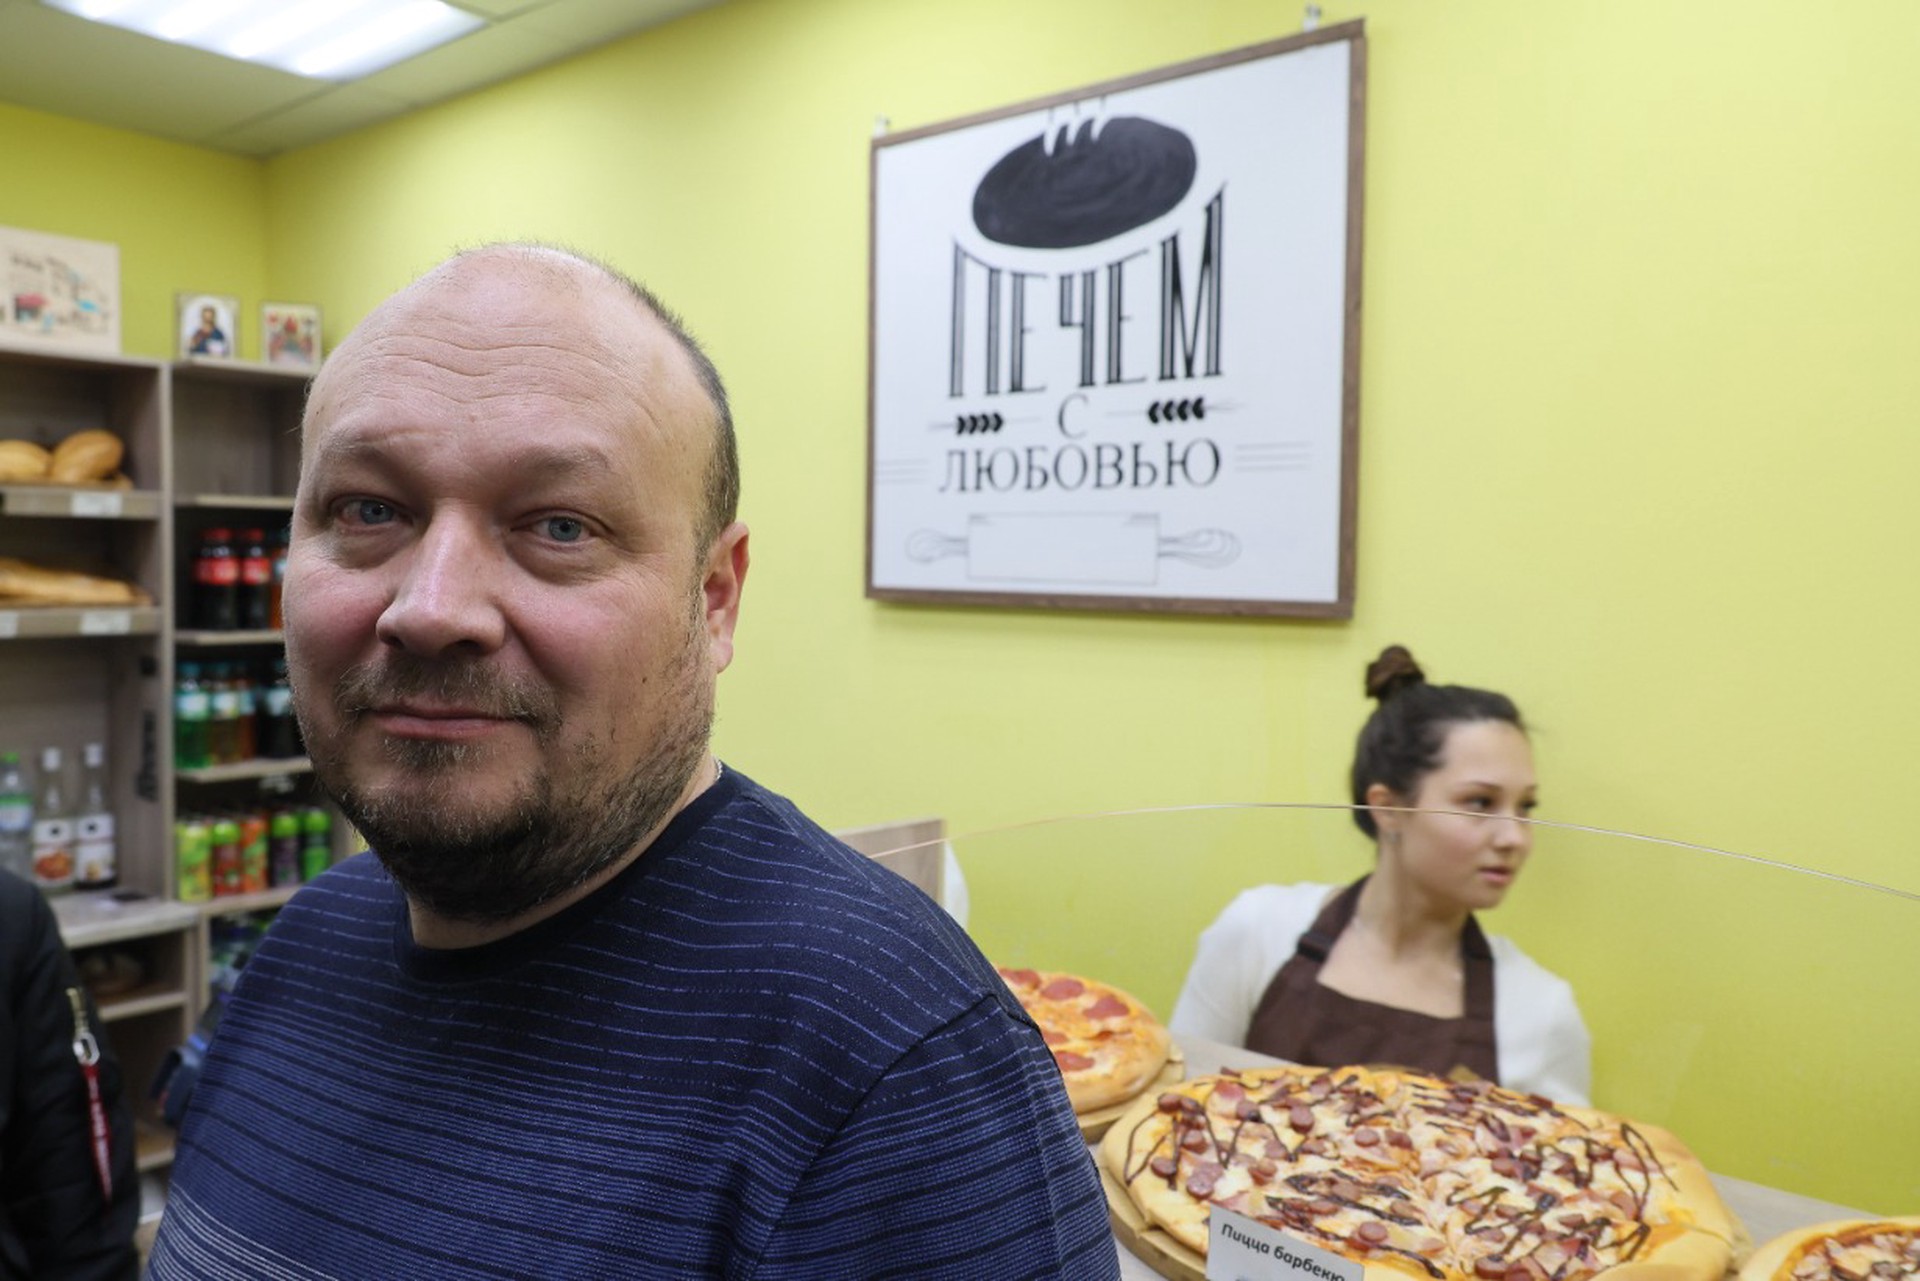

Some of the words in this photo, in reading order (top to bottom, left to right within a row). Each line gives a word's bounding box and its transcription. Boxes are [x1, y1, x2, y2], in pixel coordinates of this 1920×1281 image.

[949, 182, 1226, 398] ПЕЧЕМ
[1058, 394, 1090, 439] С
[939, 438, 1221, 493] ЛЮБОВЬЮ
[1221, 1223, 1270, 1254] Пицца
[1273, 1246, 1345, 1281] барбекю
